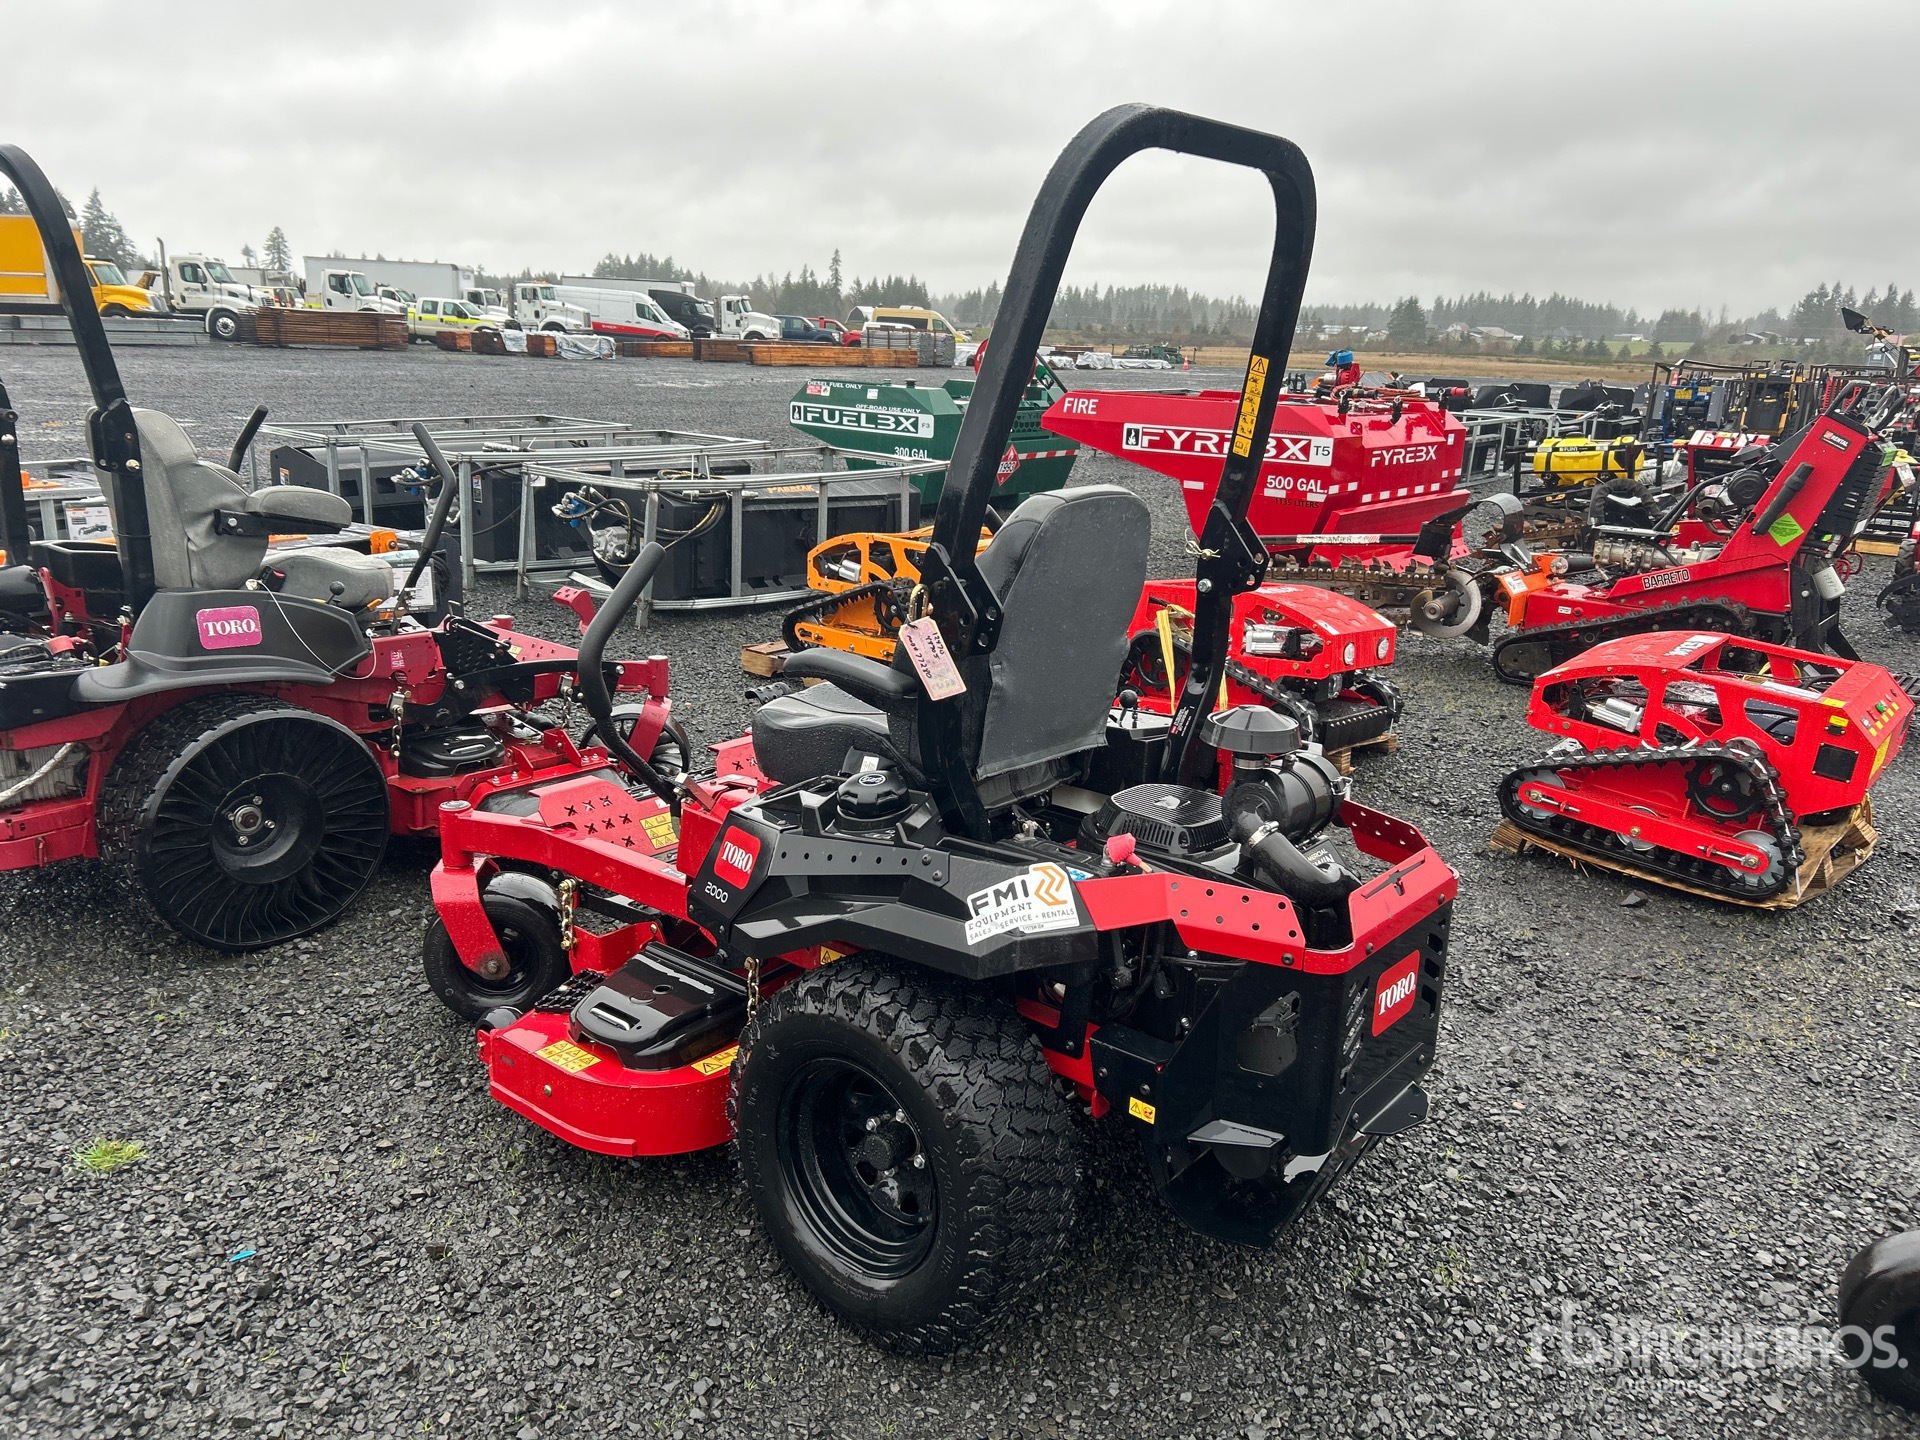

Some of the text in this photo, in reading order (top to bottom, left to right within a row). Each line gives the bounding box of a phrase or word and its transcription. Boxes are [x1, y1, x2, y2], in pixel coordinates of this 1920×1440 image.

[855, 403, 921, 415] OFF-ROAD USE ONLY
[1062, 397, 1099, 415] FIRE
[894, 446, 910, 458] 300
[1313, 445, 1331, 457] T5
[1266, 474, 1328, 494] 500 GAL.
[1642, 568, 1691, 591] BARRETO
[202, 618, 256, 637] TORO
[721, 840, 754, 874] TORO
[704, 881, 729, 904] 2000
[970, 879, 1030, 917] FMI
[968, 901, 1033, 931] EQUIPMENT
[969, 907, 1075, 941] SALES SERVICE RENTALS
[1378, 970, 1416, 1016] TORO
